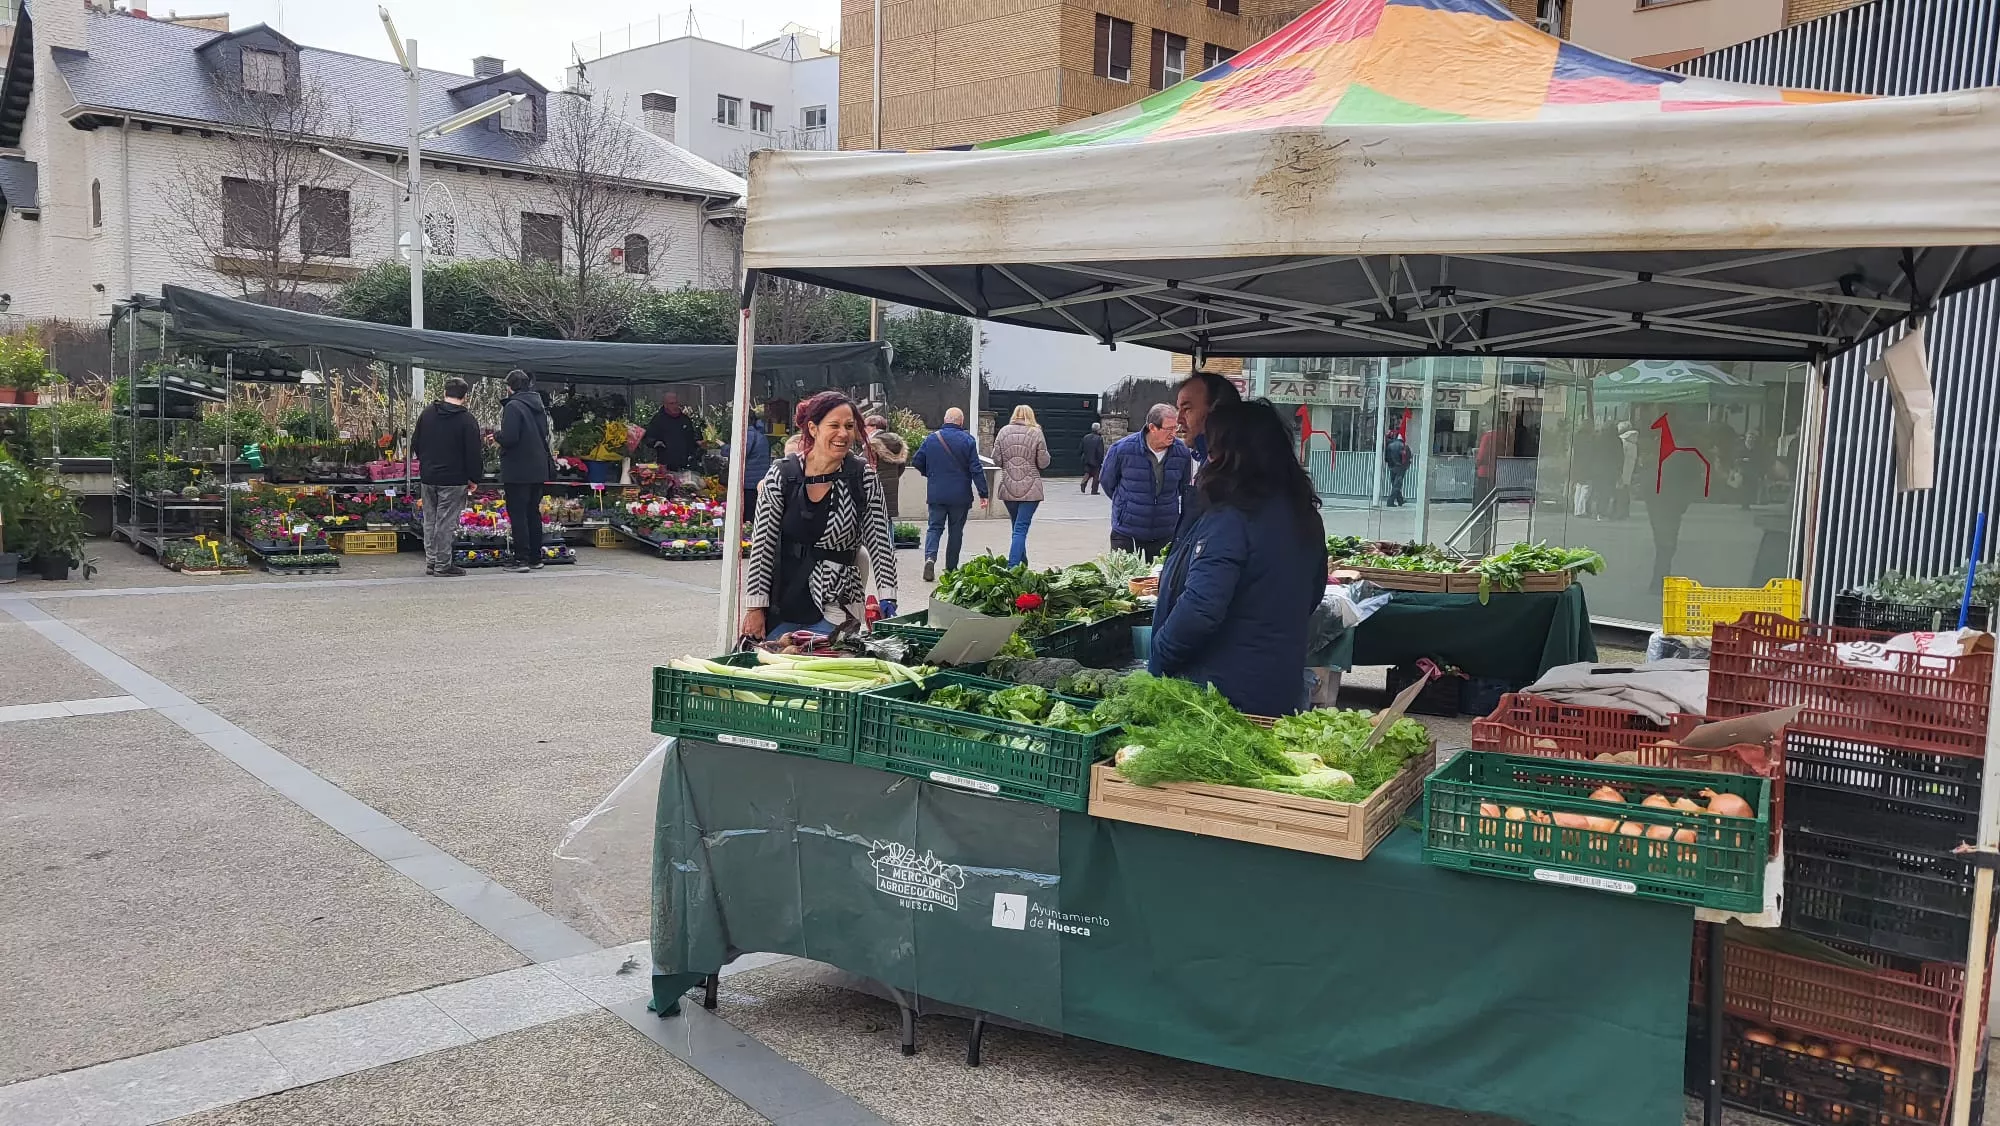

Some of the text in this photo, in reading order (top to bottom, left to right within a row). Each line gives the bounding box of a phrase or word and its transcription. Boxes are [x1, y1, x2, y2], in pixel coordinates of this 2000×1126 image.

[893, 867, 941, 888] MERCADO
[900, 898, 933, 913] HUESCA
[1031, 902, 1110, 926] Ayuntamiento
[1030, 916, 1091, 936] de Huesca
